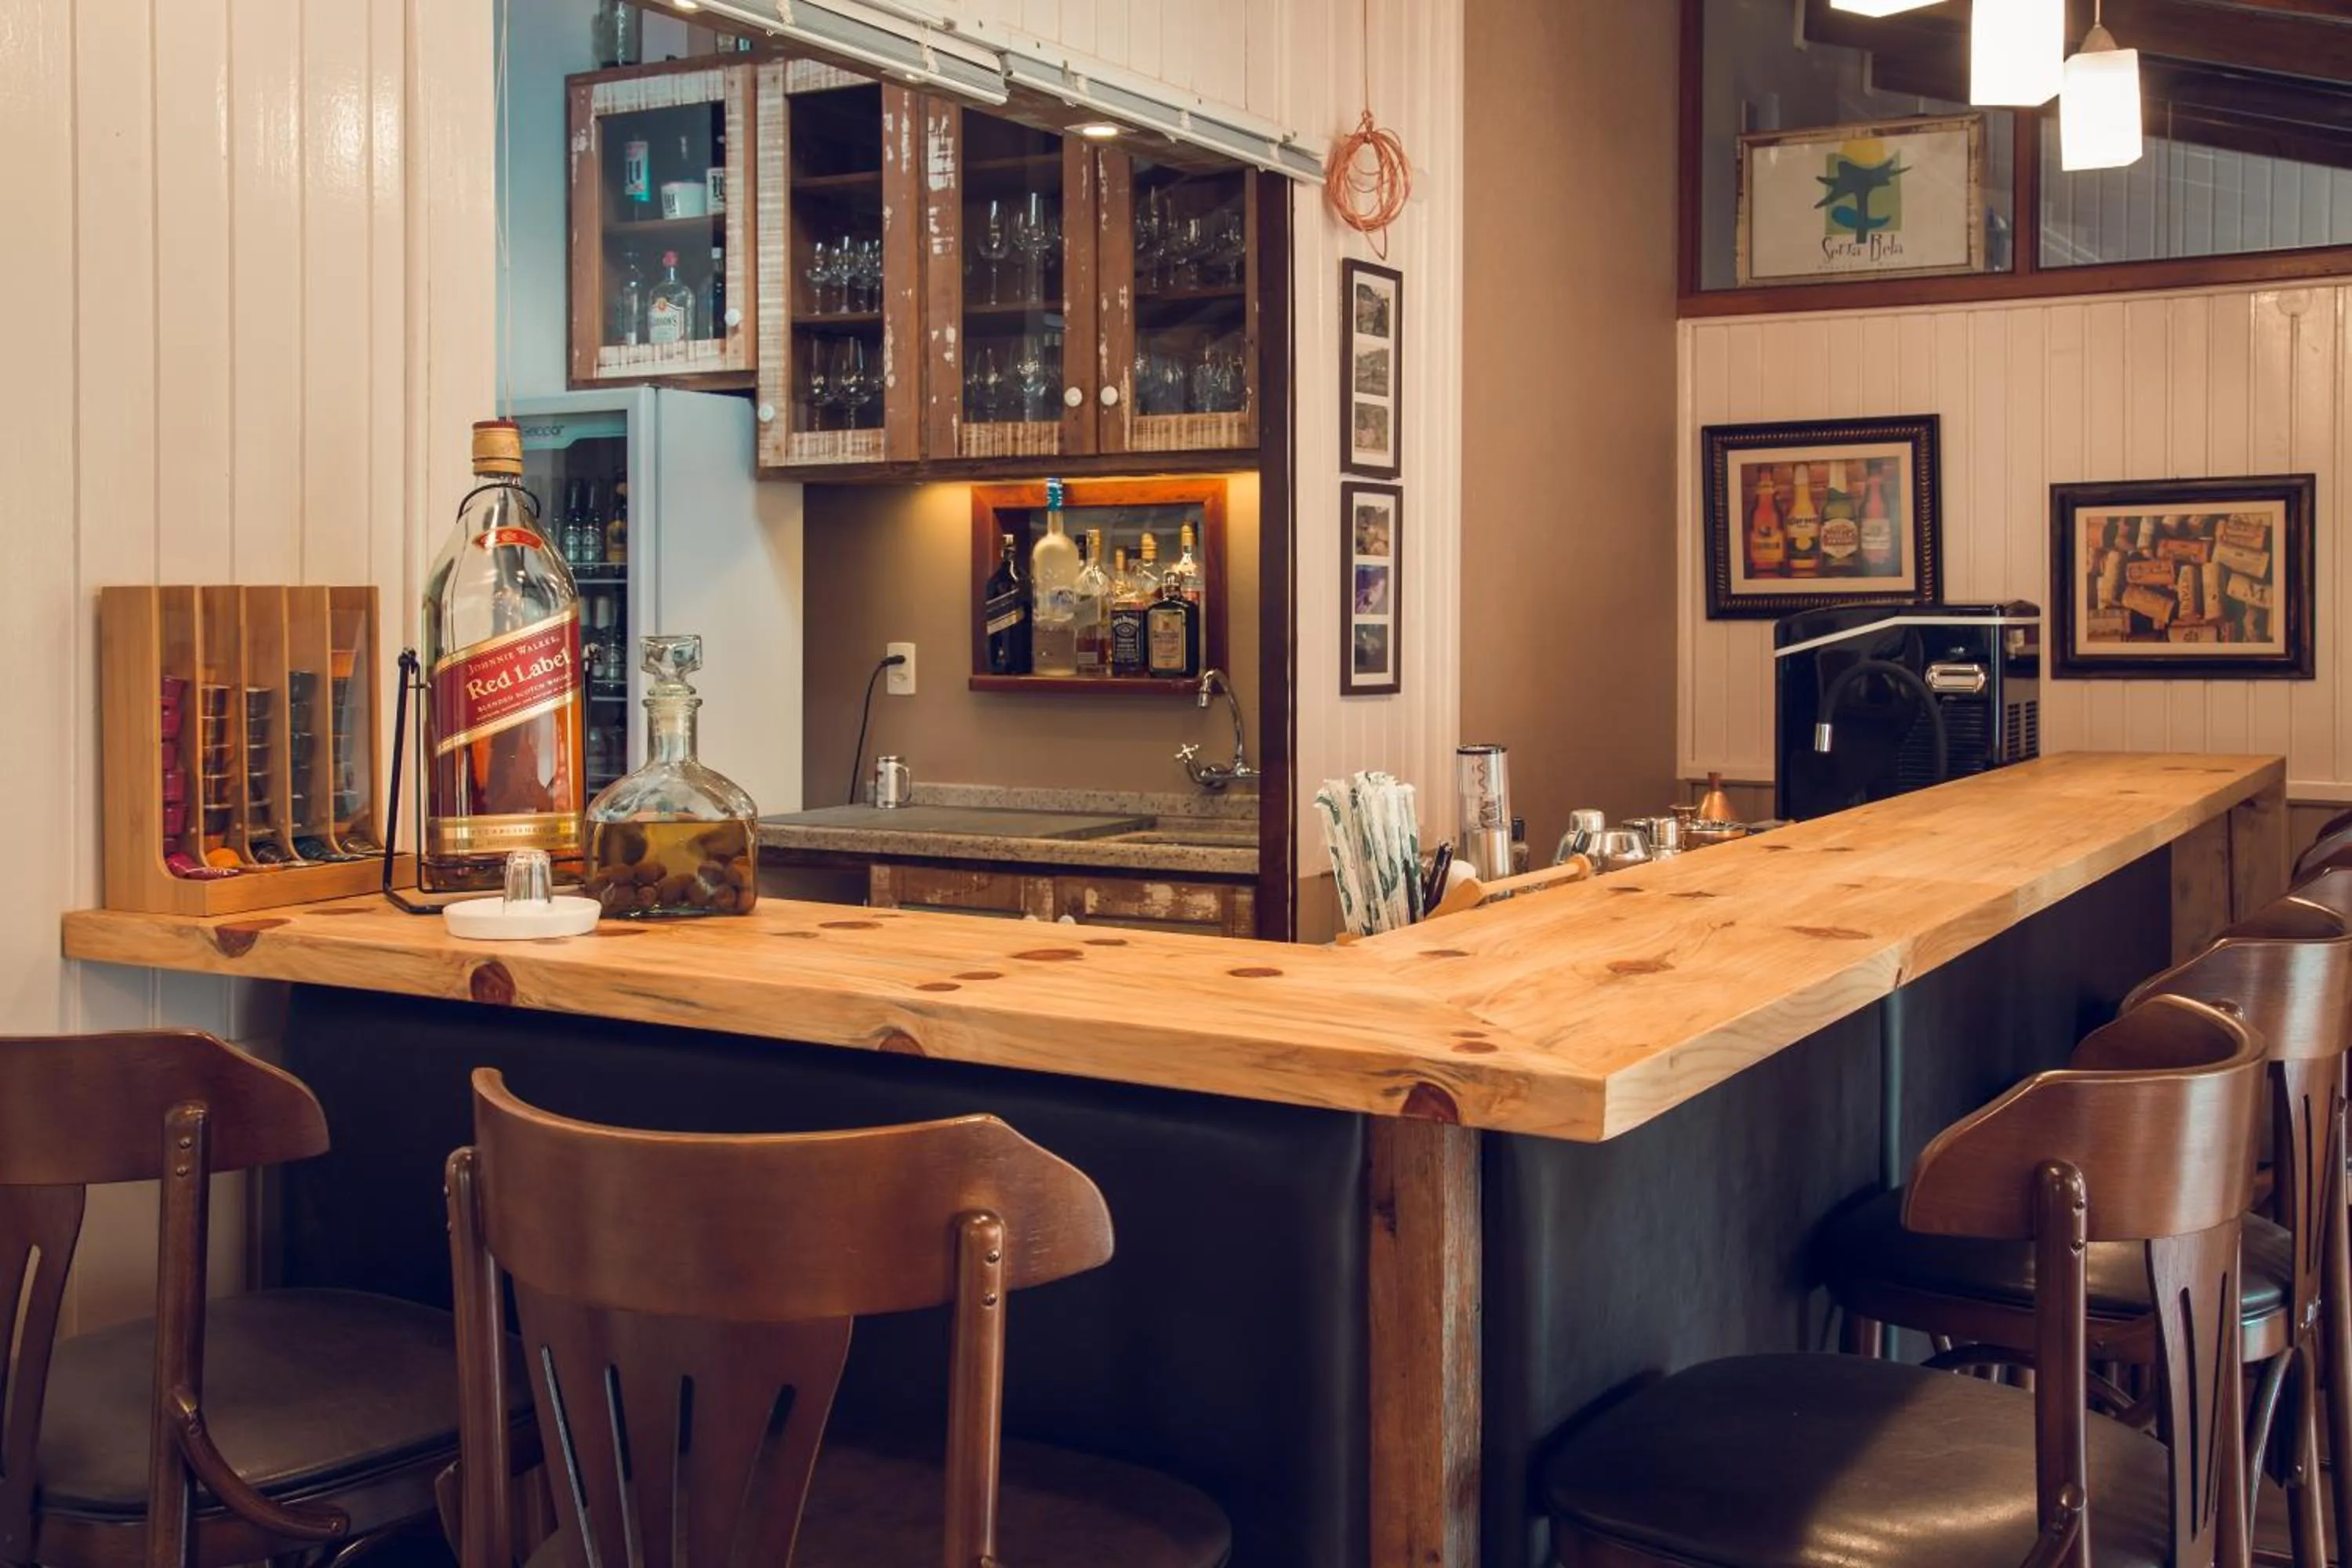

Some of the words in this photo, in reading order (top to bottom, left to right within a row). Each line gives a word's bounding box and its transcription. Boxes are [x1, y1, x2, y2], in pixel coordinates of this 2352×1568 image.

[1821, 236, 1861, 263] Serra
[1870, 233, 1904, 263] Bela
[466, 670, 513, 700] Red
[514, 647, 572, 682] Label
